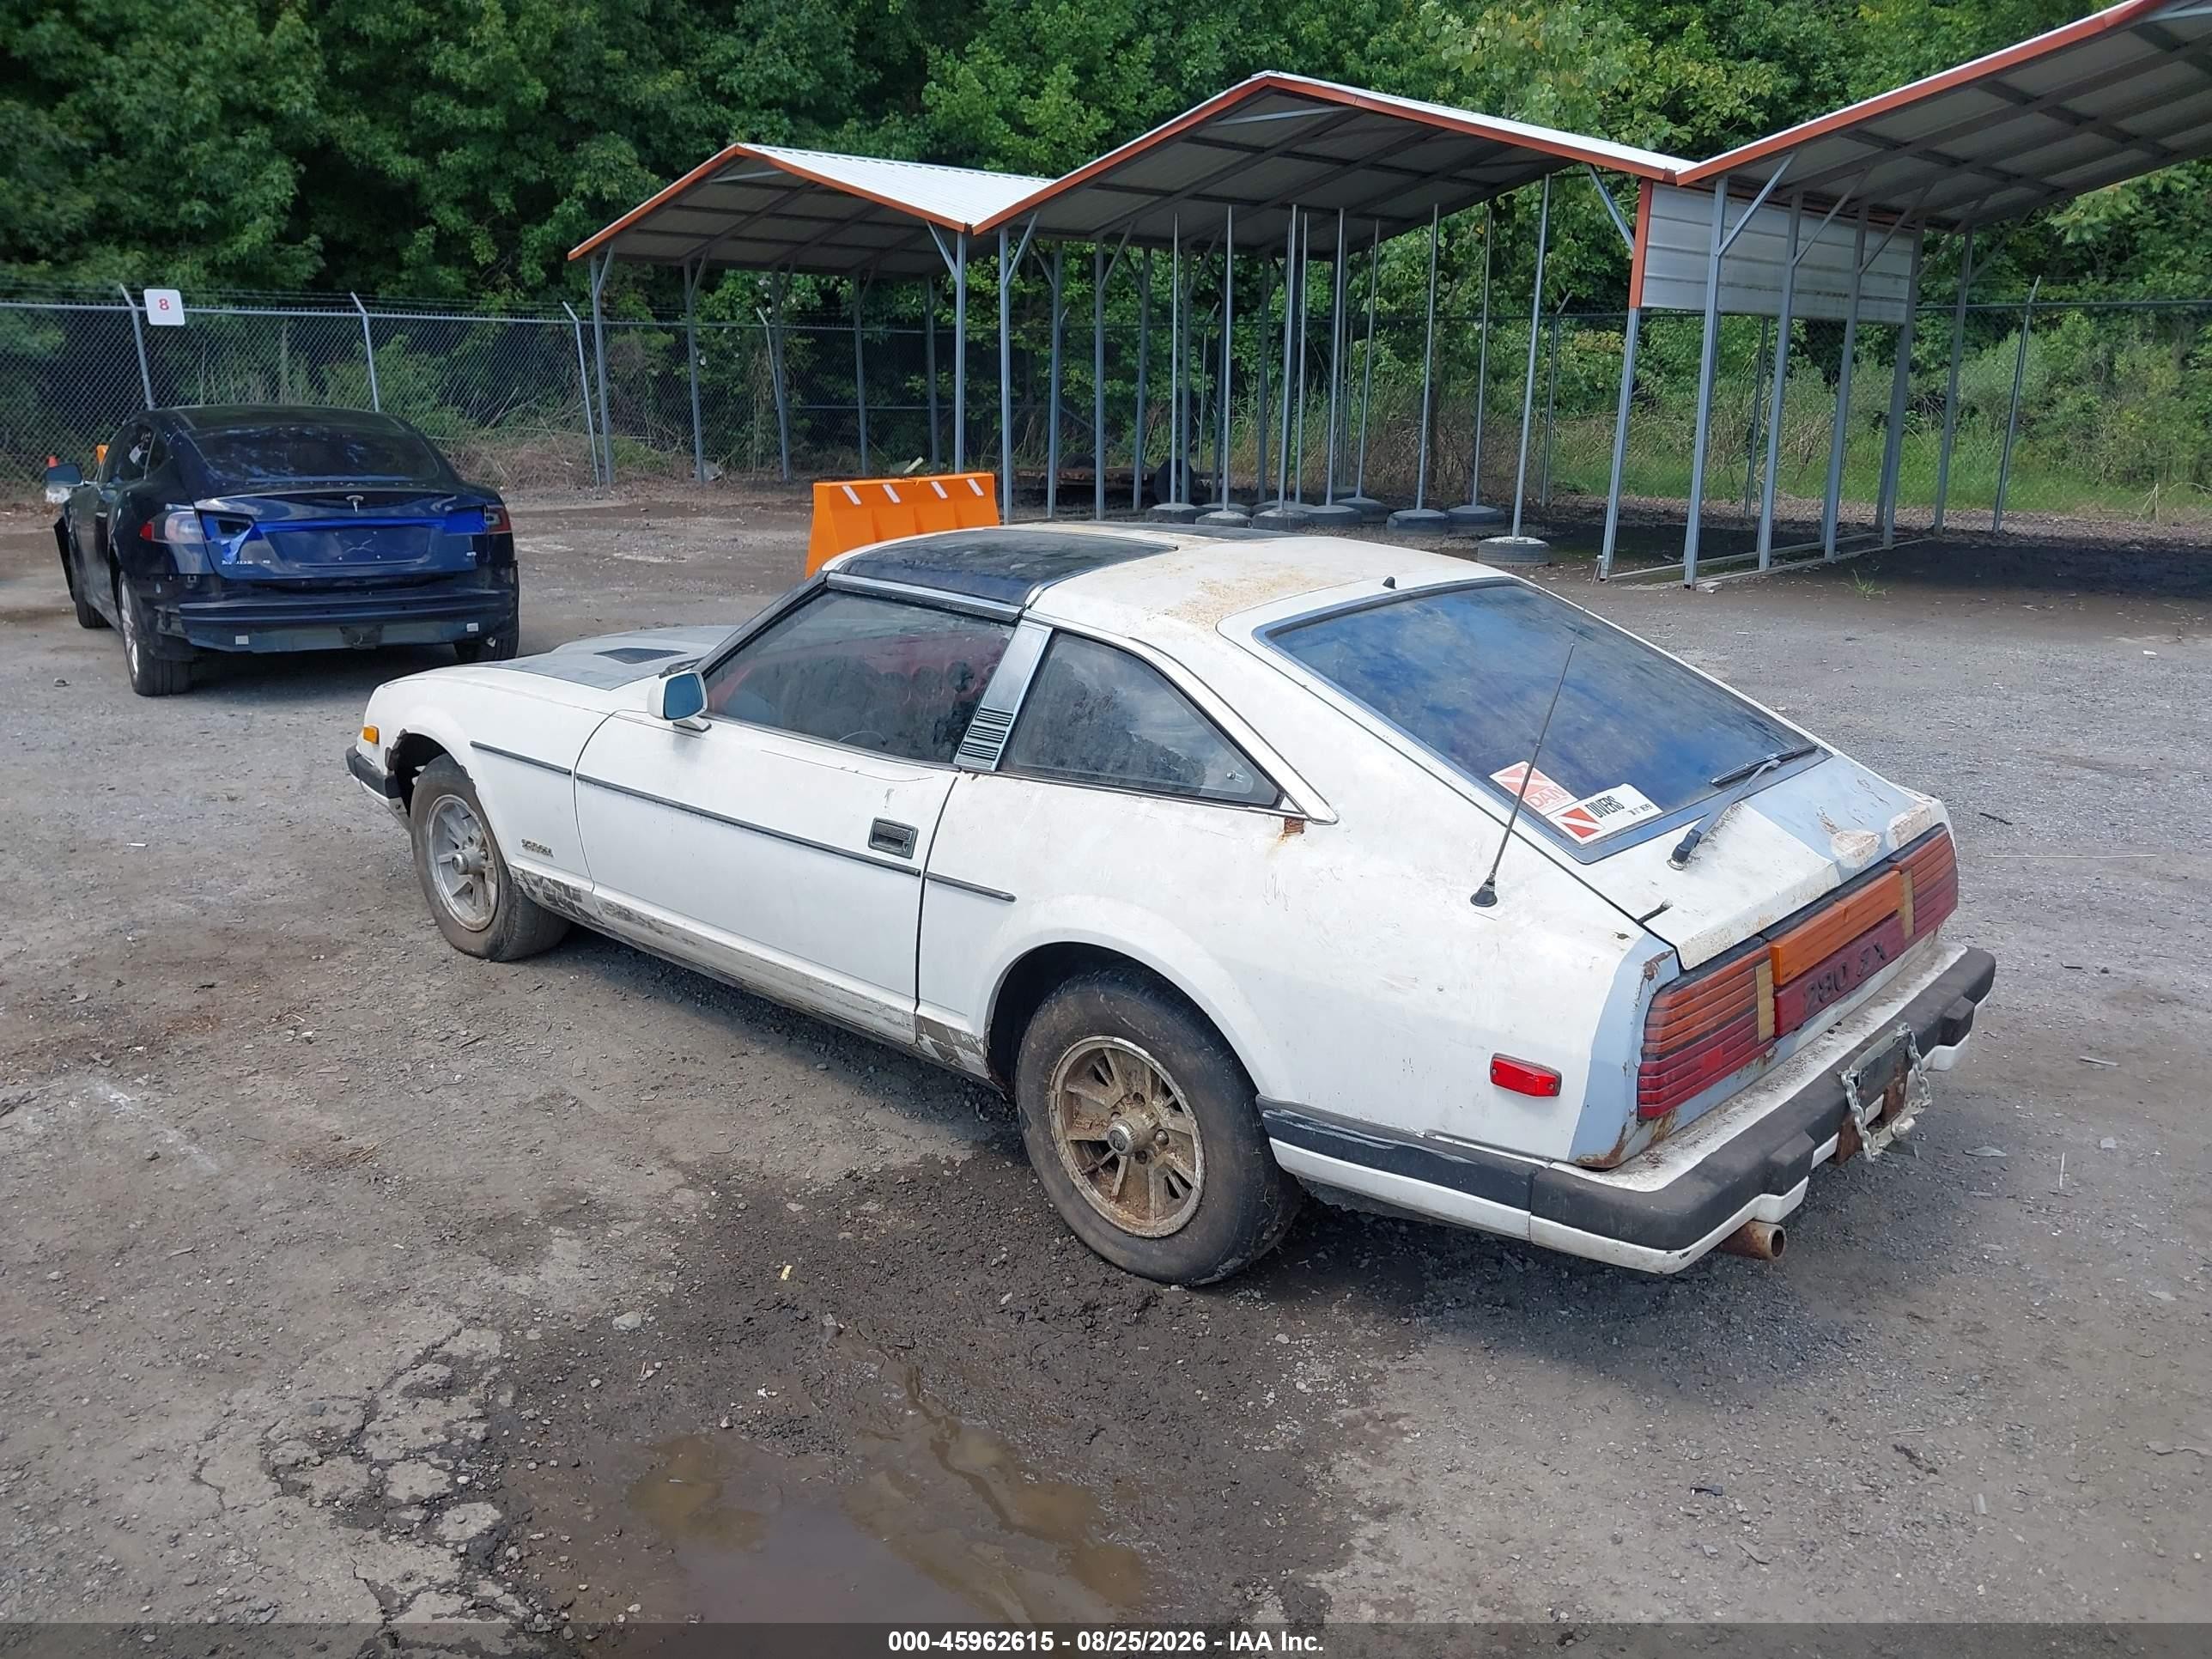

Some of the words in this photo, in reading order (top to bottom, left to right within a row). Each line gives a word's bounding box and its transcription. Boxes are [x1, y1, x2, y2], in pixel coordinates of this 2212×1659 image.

[159, 298, 169, 310] 8
[1526, 786, 1567, 808] DAN
[1584, 795, 1626, 818] DIVERS
